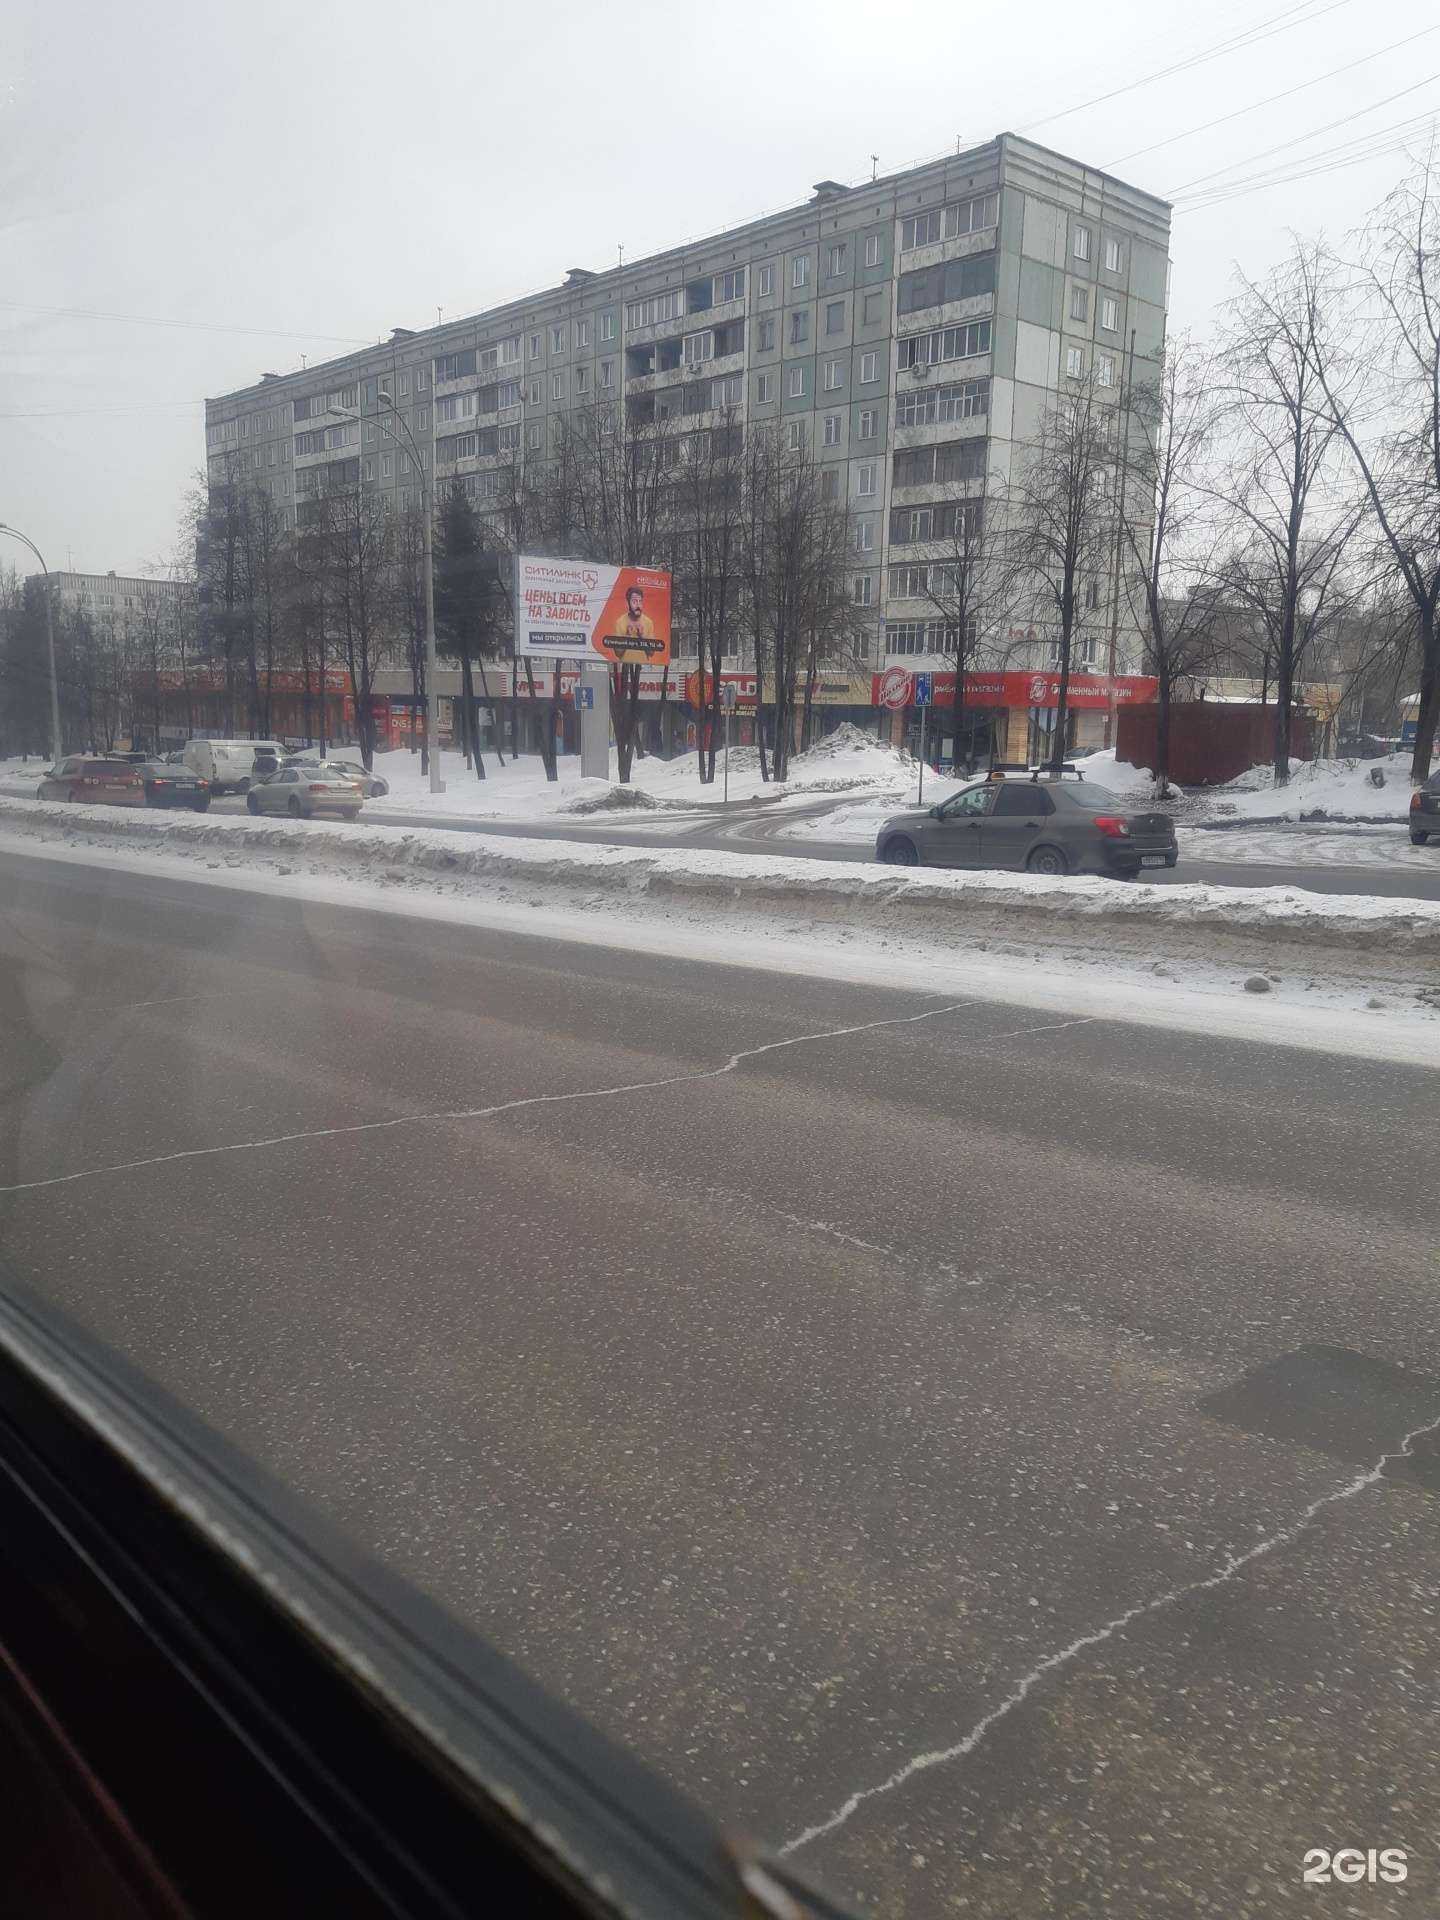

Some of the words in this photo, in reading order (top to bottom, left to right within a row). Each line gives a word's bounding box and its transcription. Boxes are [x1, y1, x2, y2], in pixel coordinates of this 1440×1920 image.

[525, 566, 581, 580] СИТИЛИНК
[525, 589, 557, 605] ЦЕНЫ
[559, 592, 587, 606] ВСЕМ
[528, 605, 543, 618] НА
[545, 607, 591, 622] ЗАВИСТЬ
